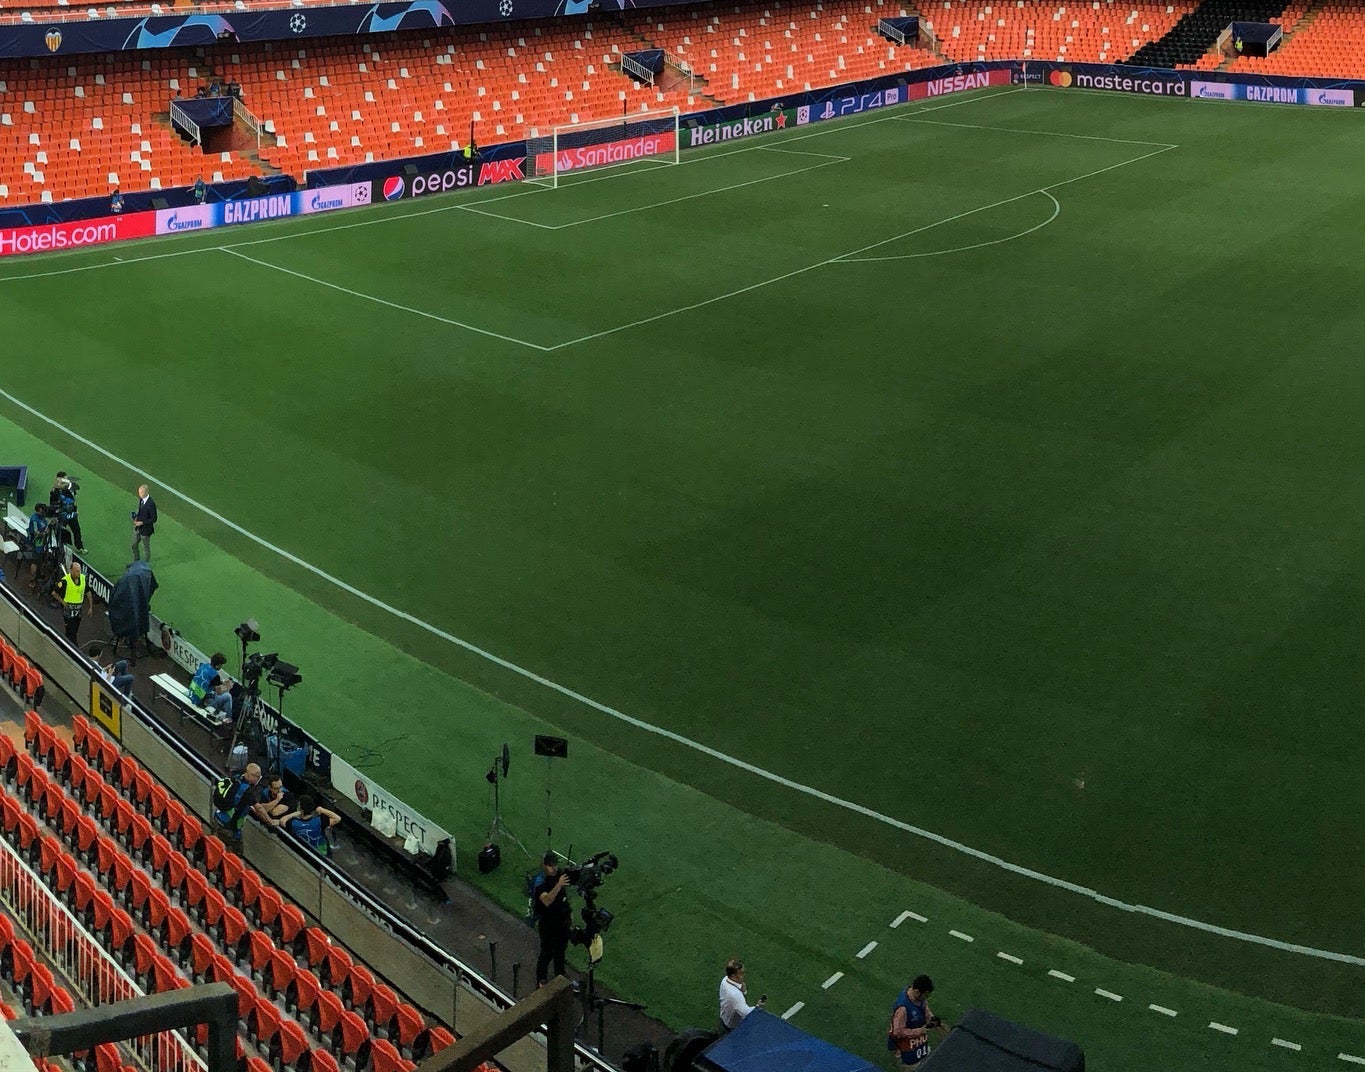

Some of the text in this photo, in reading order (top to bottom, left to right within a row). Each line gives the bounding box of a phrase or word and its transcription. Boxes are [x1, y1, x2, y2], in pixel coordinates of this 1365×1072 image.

[927, 72, 990, 97] NISSAN
[1077, 74, 1185, 96] mastercard
[1246, 86, 1298, 103] GAZPROM
[841, 91, 898, 115] PS4 Pro
[691, 116, 773, 147] Heineken
[575, 137, 661, 168] Santander
[412, 157, 527, 197] pepsi MAX
[224, 194, 291, 225] GAZPROM
[0, 221, 117, 254] Hotels.com
[174, 640, 199, 669] RESPE
